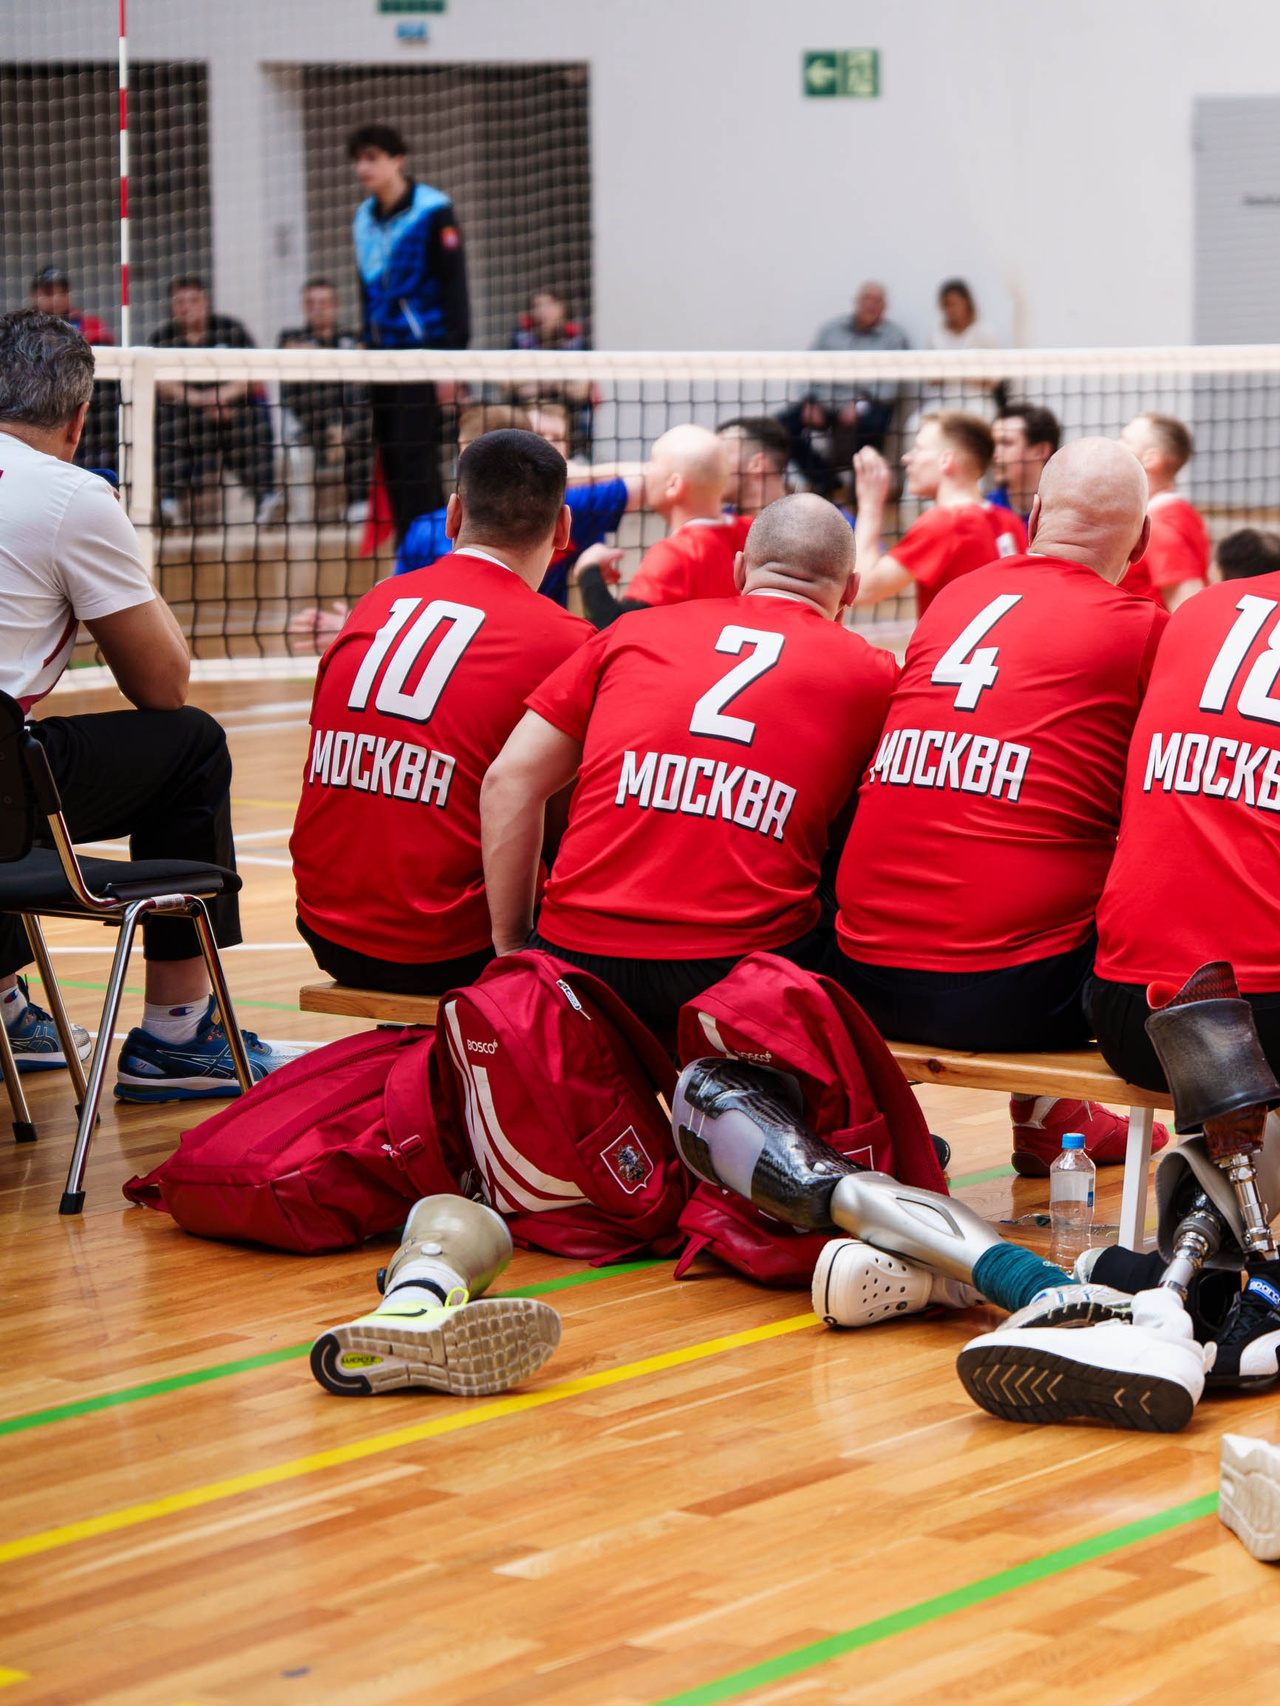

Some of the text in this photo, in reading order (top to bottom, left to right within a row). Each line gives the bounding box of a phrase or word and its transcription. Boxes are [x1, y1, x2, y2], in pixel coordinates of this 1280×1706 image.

[347, 597, 486, 723] 10
[688, 624, 786, 746] 2
[930, 594, 1023, 712] 4
[309, 729, 457, 808] МОСКВА
[615, 750, 798, 841] МОСКВА
[869, 728, 1032, 804] МОСКВА
[466, 1038, 496, 1055] BOSCO
